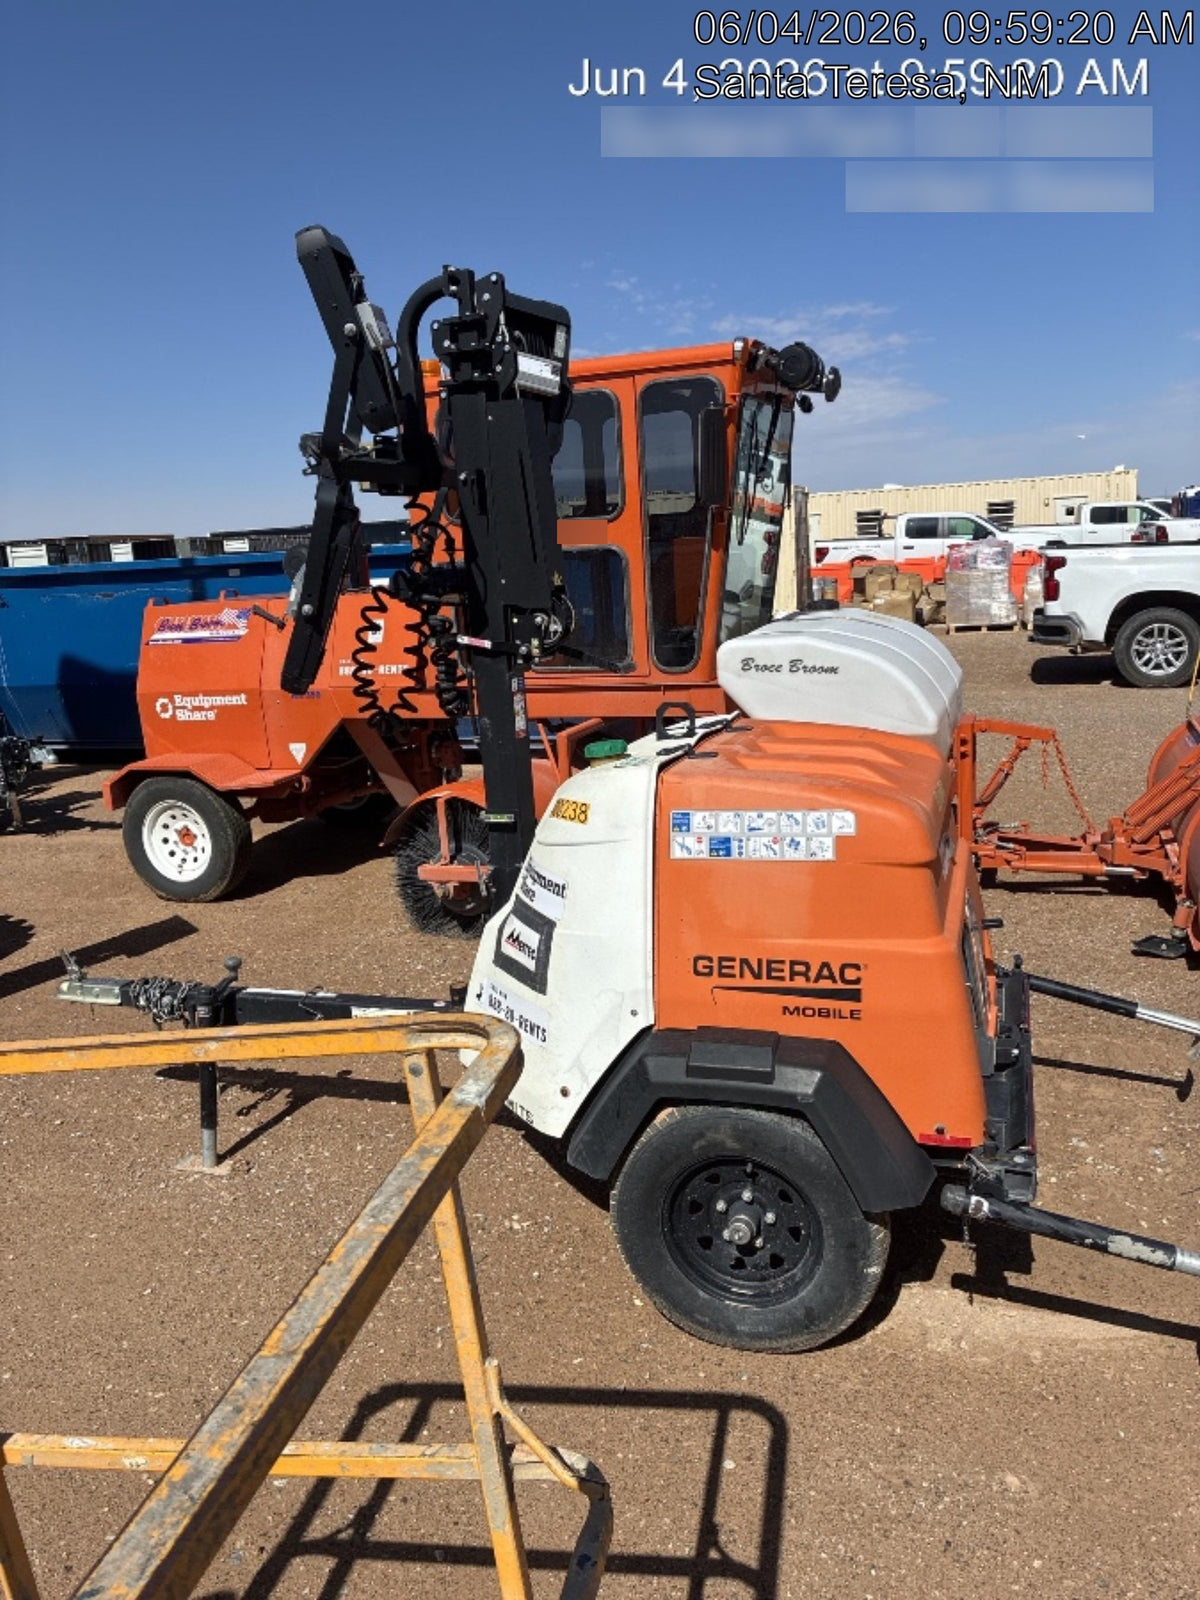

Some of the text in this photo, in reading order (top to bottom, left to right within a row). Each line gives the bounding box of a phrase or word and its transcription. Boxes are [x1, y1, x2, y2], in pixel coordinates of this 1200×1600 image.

[740, 656, 840, 675] Broce Broom
[173, 692, 247, 709] Equipment
[176, 708, 216, 721] Share
[692, 954, 863, 986] GENERAC
[781, 1005, 862, 1021] MOBILE
